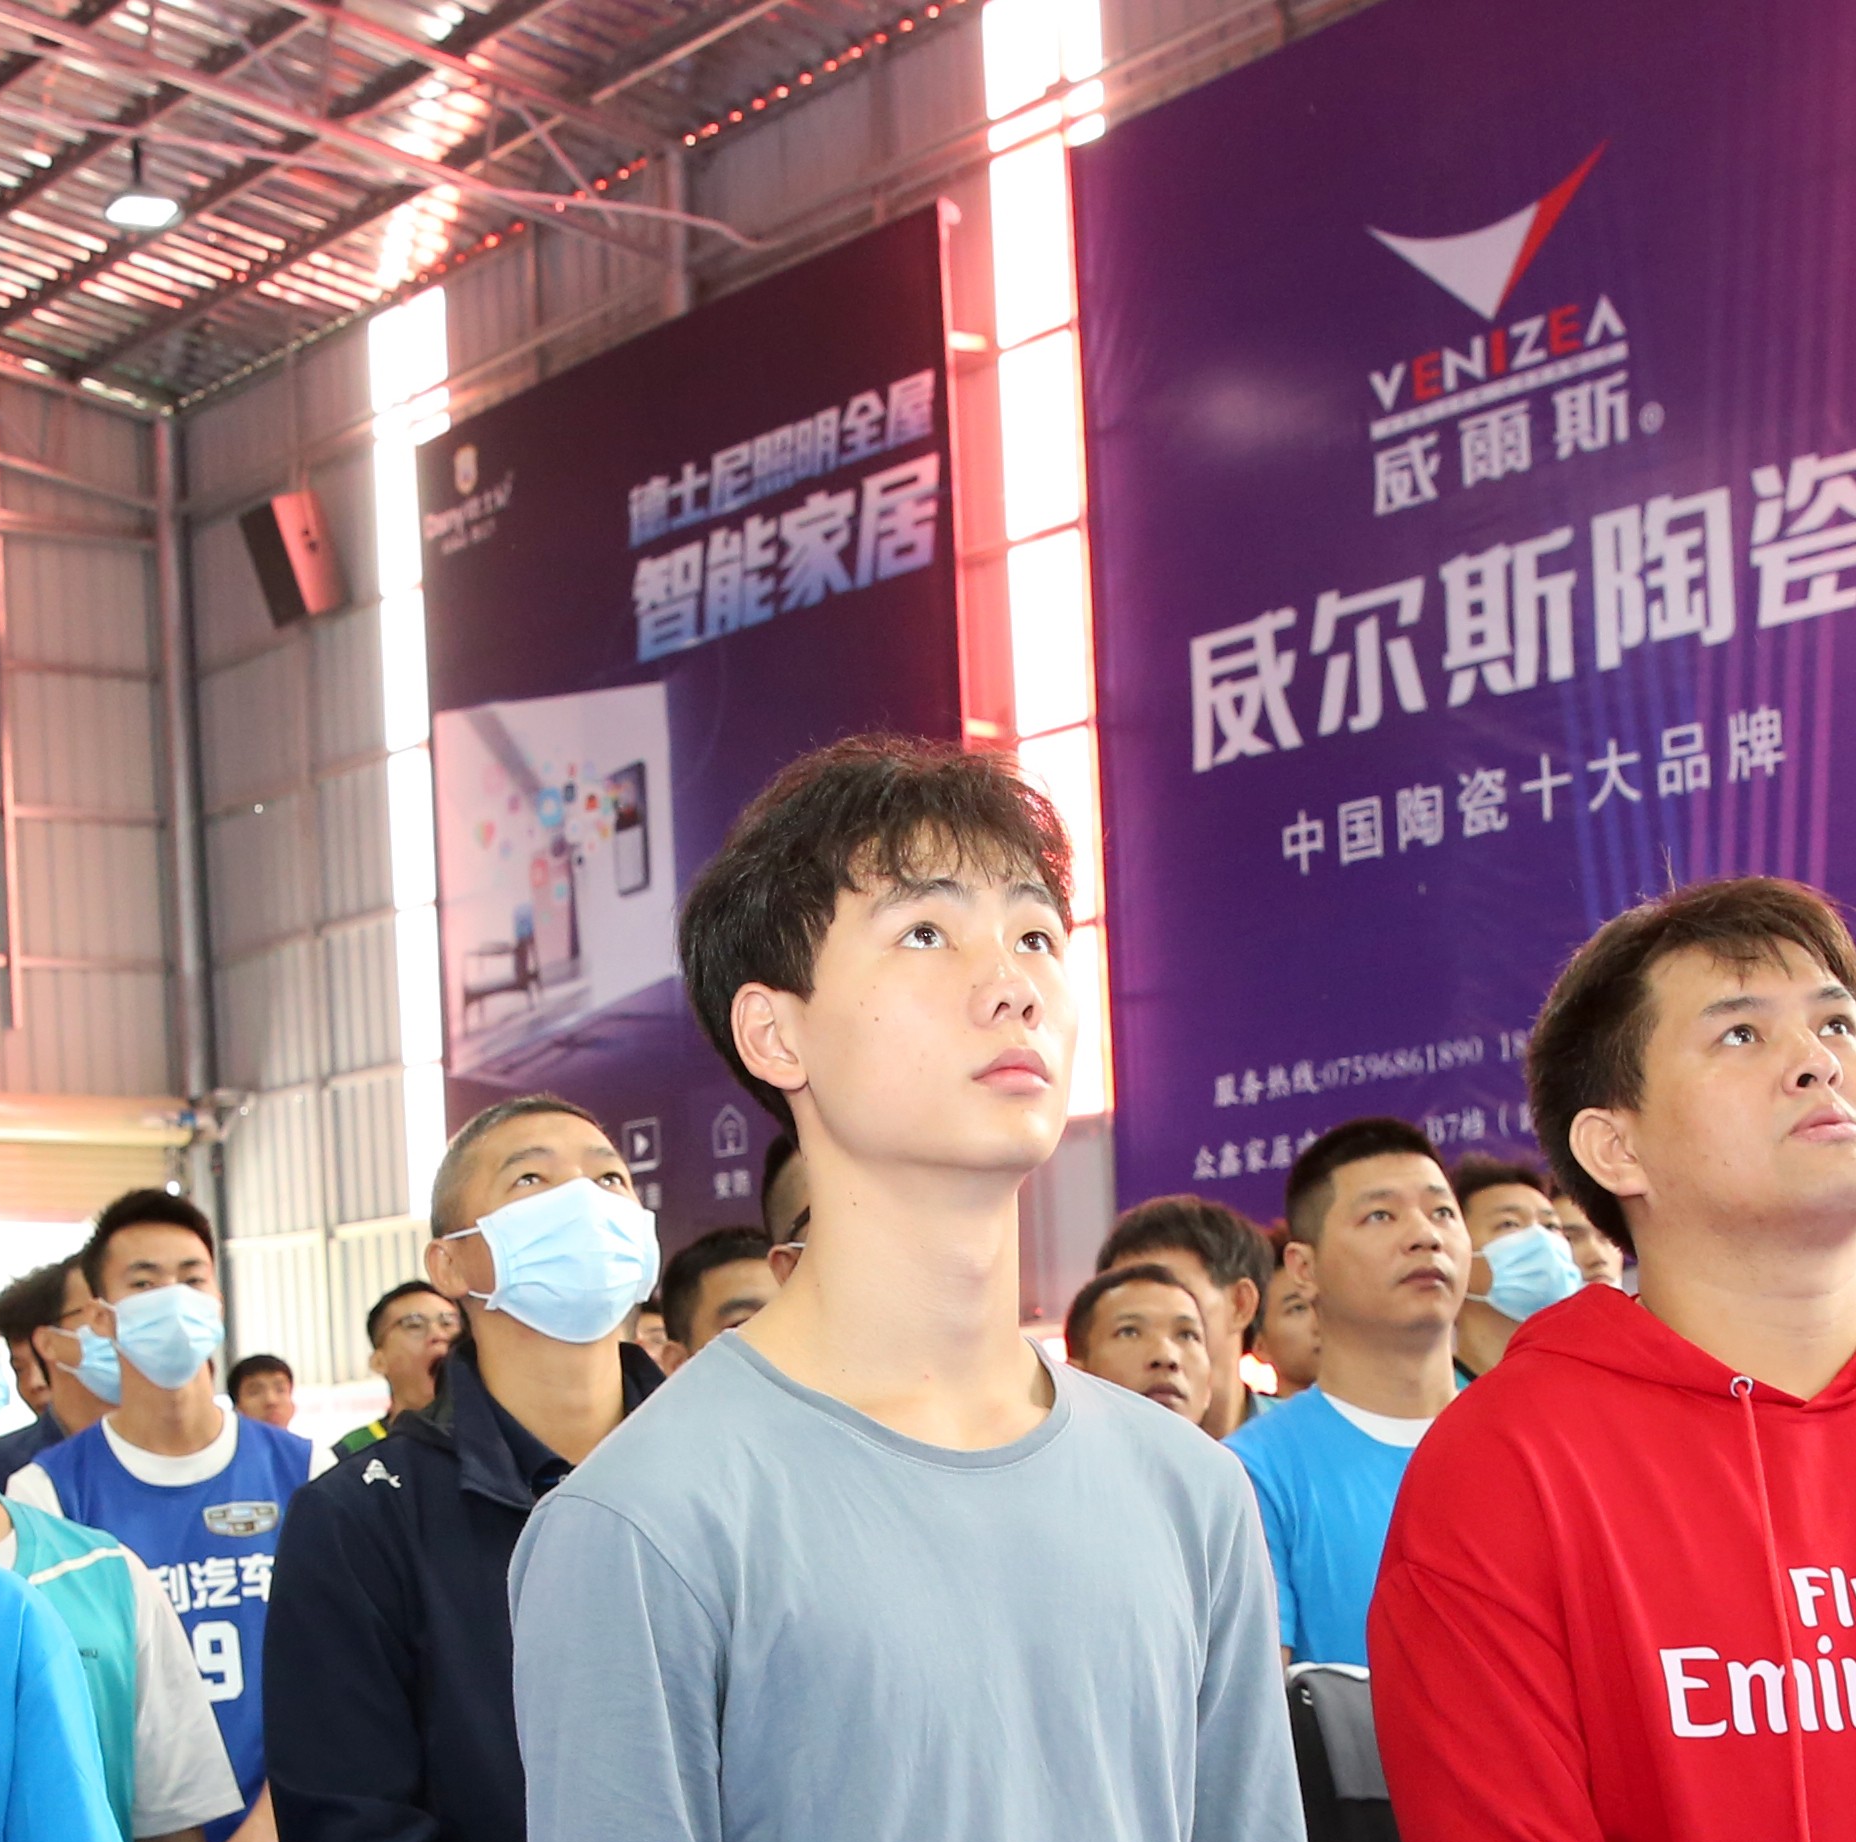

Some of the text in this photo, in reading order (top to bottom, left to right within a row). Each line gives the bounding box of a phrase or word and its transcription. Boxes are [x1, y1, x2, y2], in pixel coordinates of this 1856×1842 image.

[632, 452, 941, 663] 智能家居
[1281, 706, 1786, 875] 中国陶瓷十大品牌
